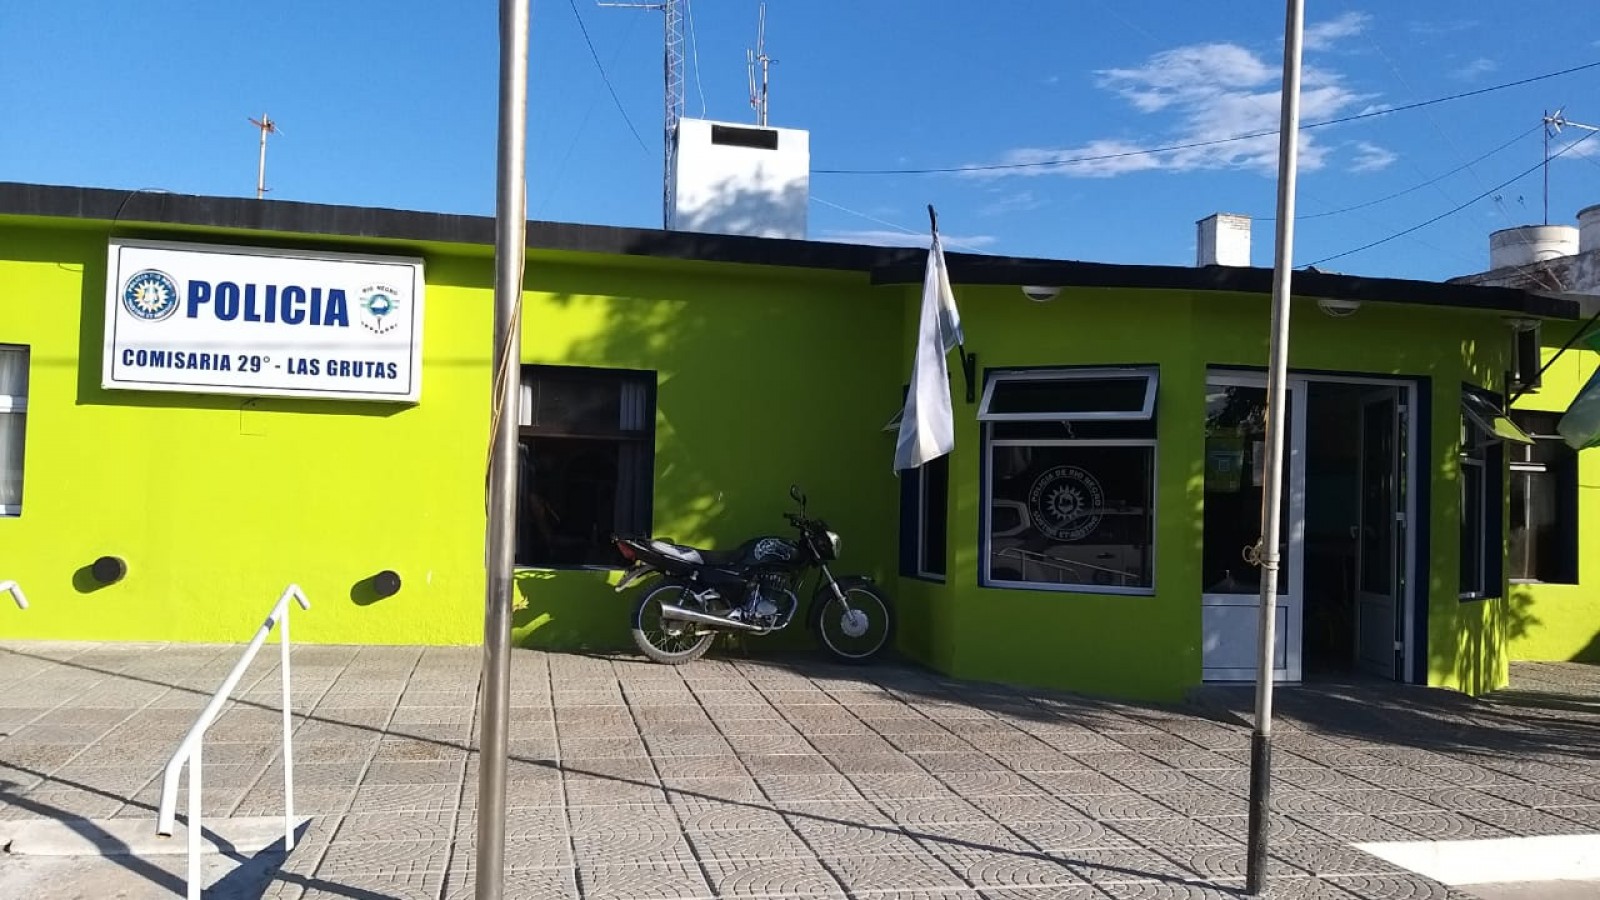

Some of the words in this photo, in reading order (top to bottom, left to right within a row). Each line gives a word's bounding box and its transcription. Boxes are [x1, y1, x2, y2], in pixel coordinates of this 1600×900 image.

[186, 279, 350, 327] POLICIA
[122, 348, 231, 371] COMISARIA
[287, 357, 321, 375] LAS
[326, 358, 398, 379] GRUTAS
[1031, 473, 1054, 502] POLICIA
